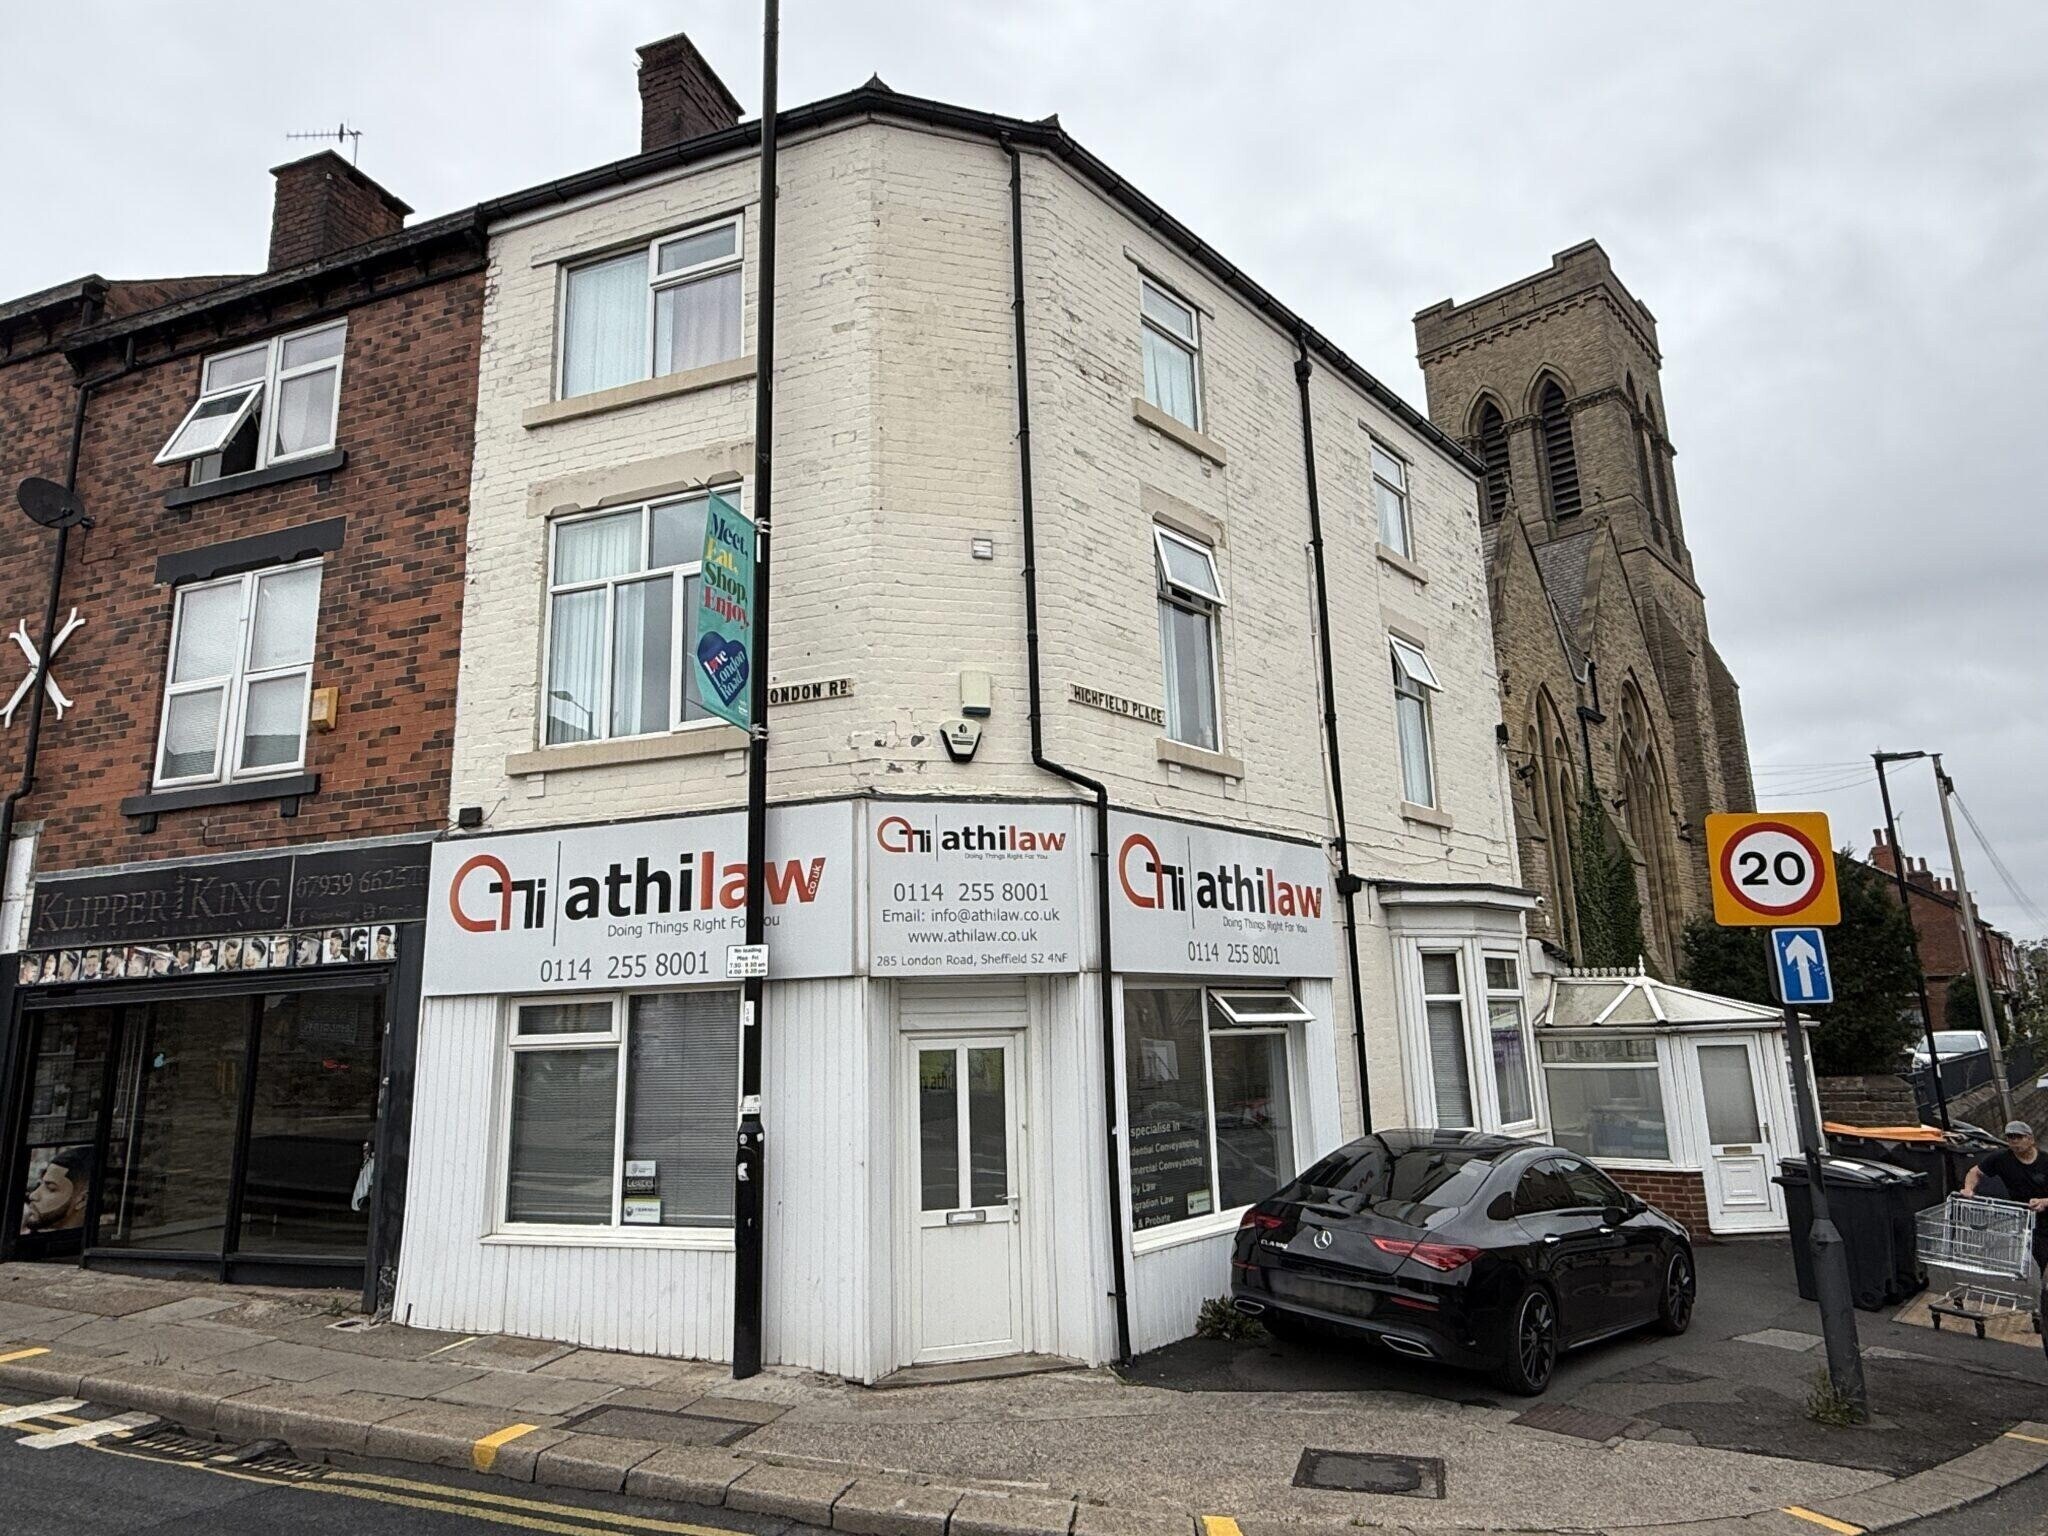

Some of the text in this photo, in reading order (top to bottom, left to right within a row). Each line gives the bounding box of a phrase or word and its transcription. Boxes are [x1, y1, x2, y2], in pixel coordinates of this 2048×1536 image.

[712, 651, 746, 687] London
[720, 670, 744, 700] Road
[770, 683, 821, 703] ONDON
[1074, 686, 1163, 723] HIGHFIELD PLACE
[941, 825, 1066, 851] athilaw
[1739, 851, 1806, 886] 20
[893, 883, 1049, 902] 0114 255 8001
[1197, 864, 1322, 918] athilaw
[607, 915, 780, 938] Doing Things Right Fo ou
[882, 908, 1060, 922] Email: info@athilaw.co.uk
[1222, 916, 1307, 933] Doing Things Right For You
[908, 928, 1038, 943] www.athilaw.co.uk
[877, 953, 1068, 967] 285 London Road, Sheffield S2 4NF
[1188, 941, 1280, 965] 0114 255 8001
[540, 951, 709, 983] 0114 255 8001
